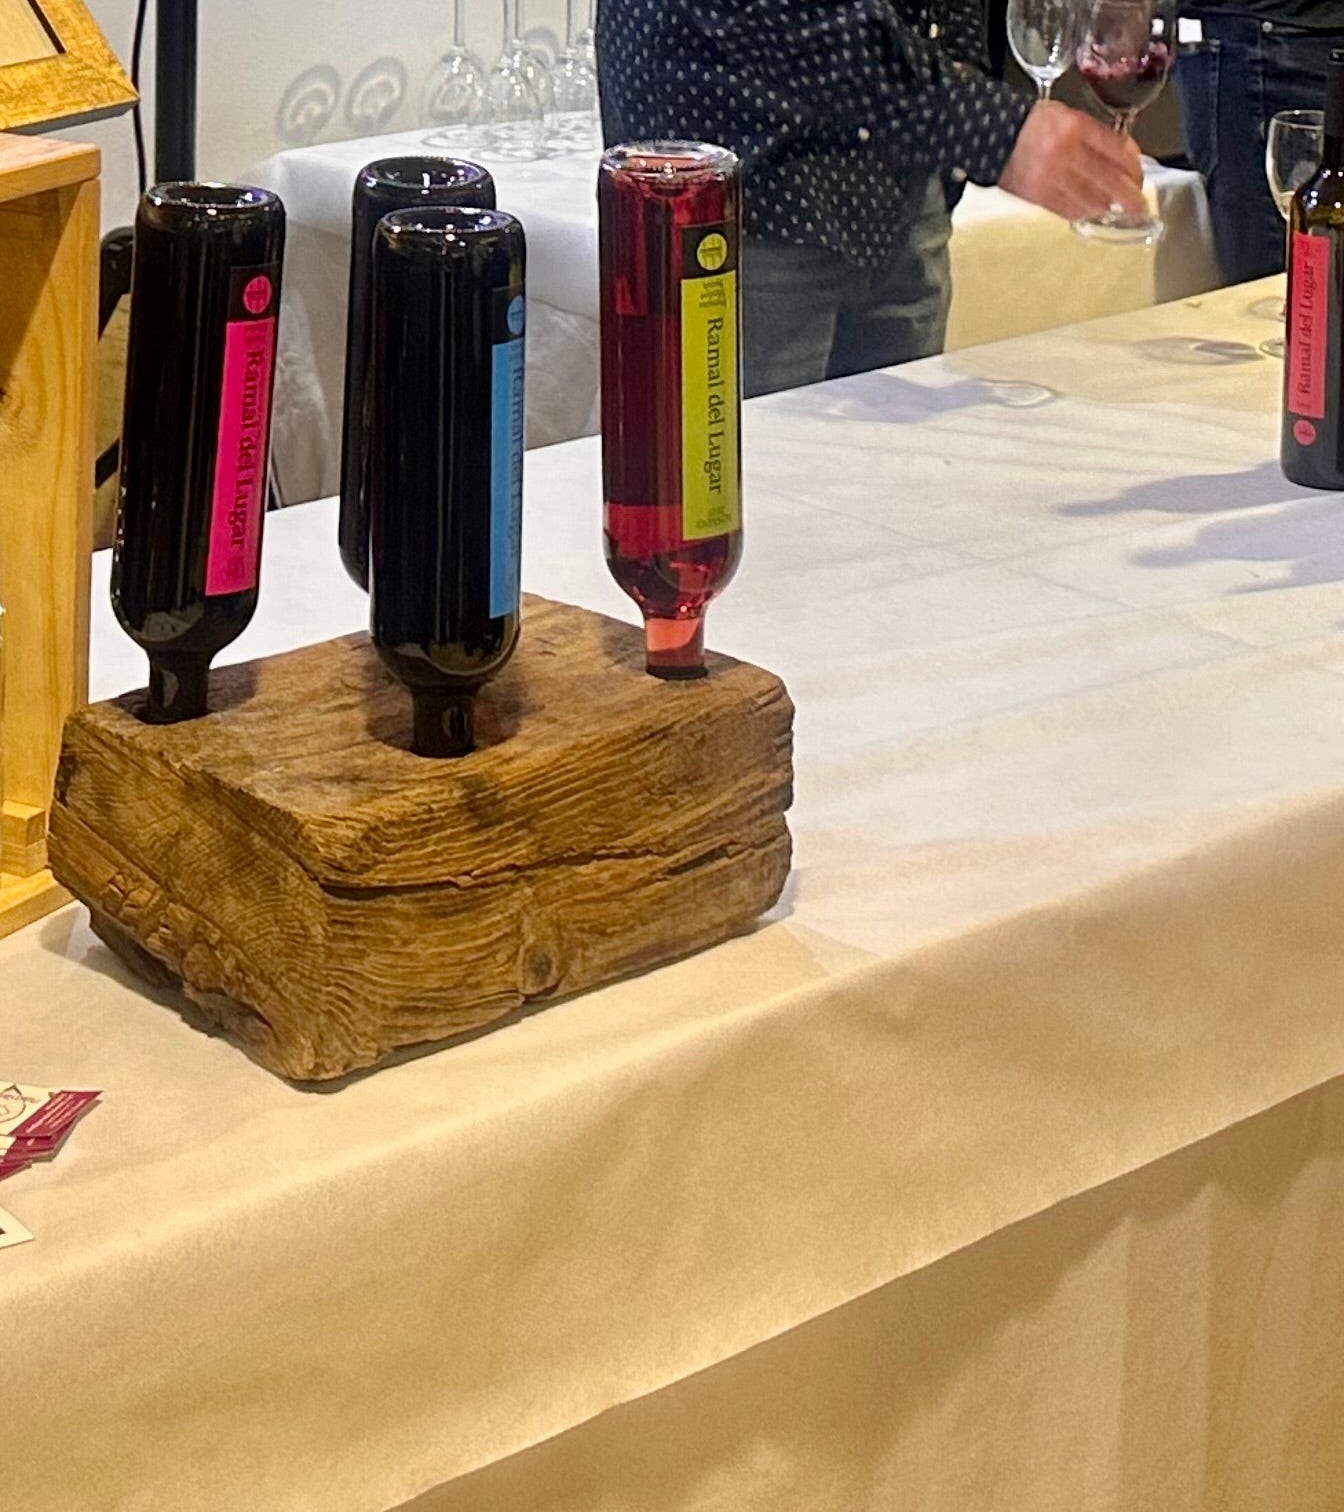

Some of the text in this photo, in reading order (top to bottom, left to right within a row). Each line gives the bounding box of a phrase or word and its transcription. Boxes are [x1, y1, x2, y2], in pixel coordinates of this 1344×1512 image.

[706, 316, 725, 389] Ramal
[1297, 261, 1317, 394] Ramal del Lugar
[707, 393, 725, 426] del
[227, 349, 264, 553] Ramal del Lugar
[703, 431, 725, 495] Lugar
